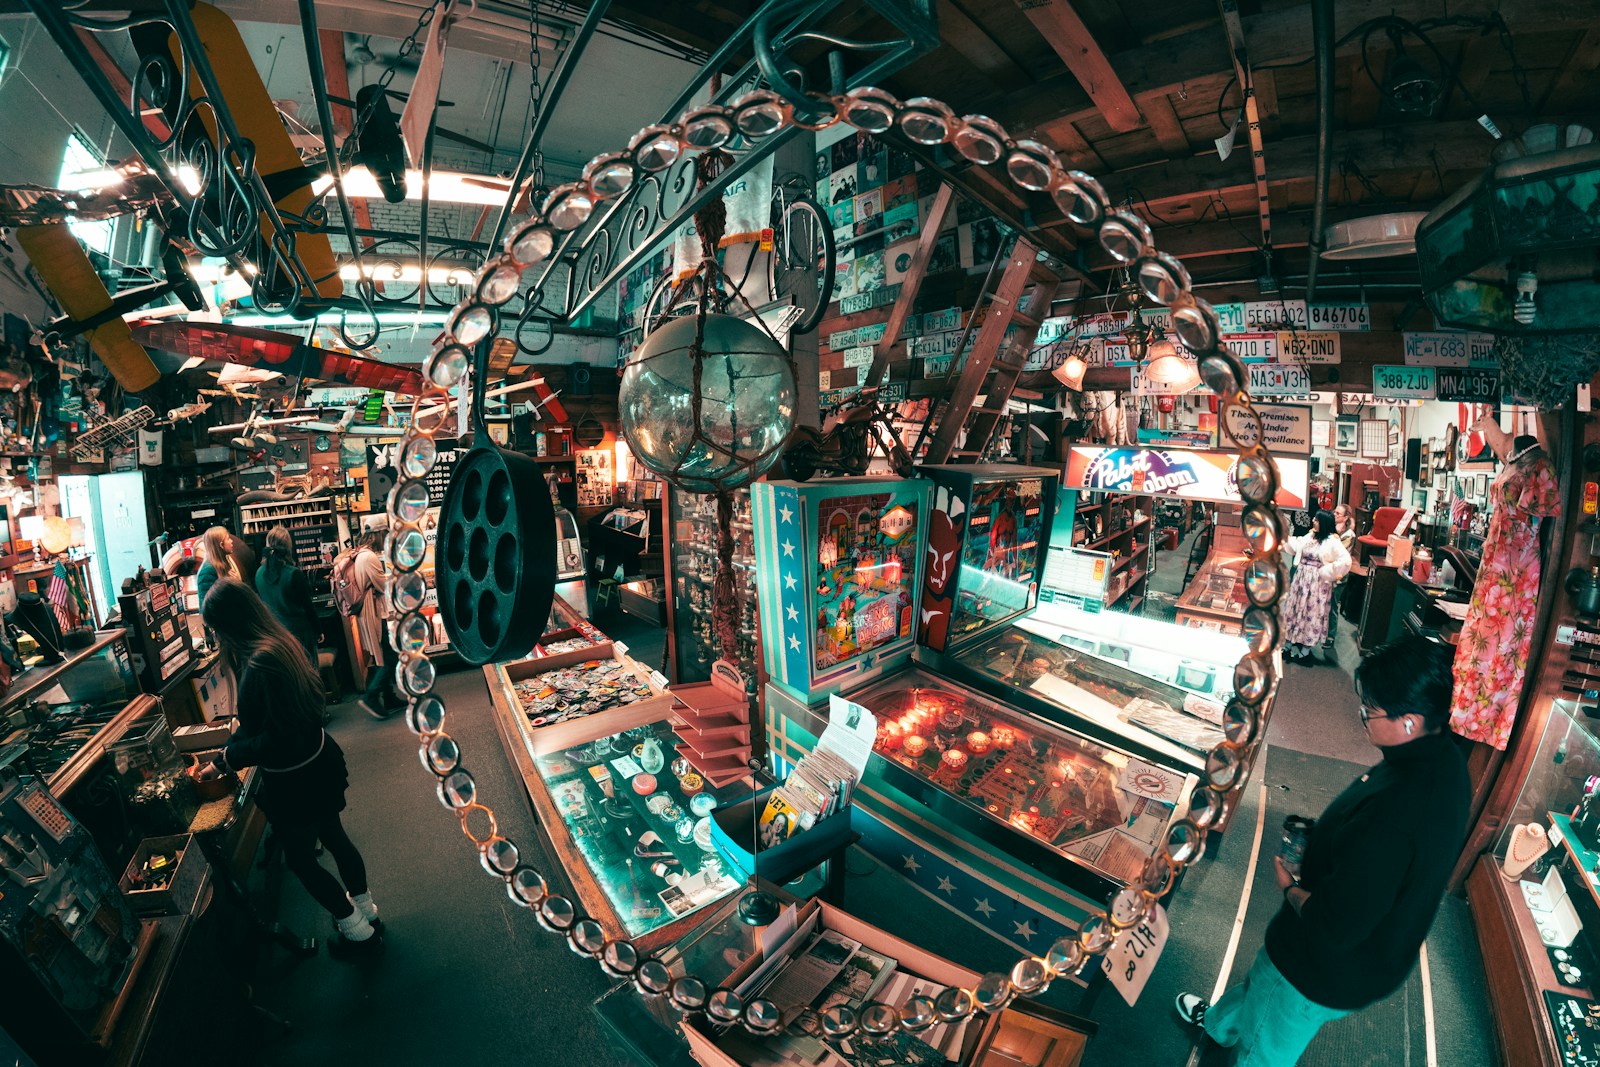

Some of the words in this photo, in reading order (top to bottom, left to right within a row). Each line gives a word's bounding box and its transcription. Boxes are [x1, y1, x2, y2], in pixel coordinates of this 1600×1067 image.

[1248, 307, 1306, 325] 5EG1602
[1312, 307, 1366, 324] 846706
[1107, 346, 1127, 361] DSX
[1160, 398, 1173, 406] FIRE
[1260, 411, 1299, 421] Premises
[1263, 423, 1289, 432] Under
[1251, 433, 1305, 445] Srveillance
[1098, 450, 1151, 488] Pabst
[859, 615, 895, 644] ALONG
[769, 795, 787, 812] JET
